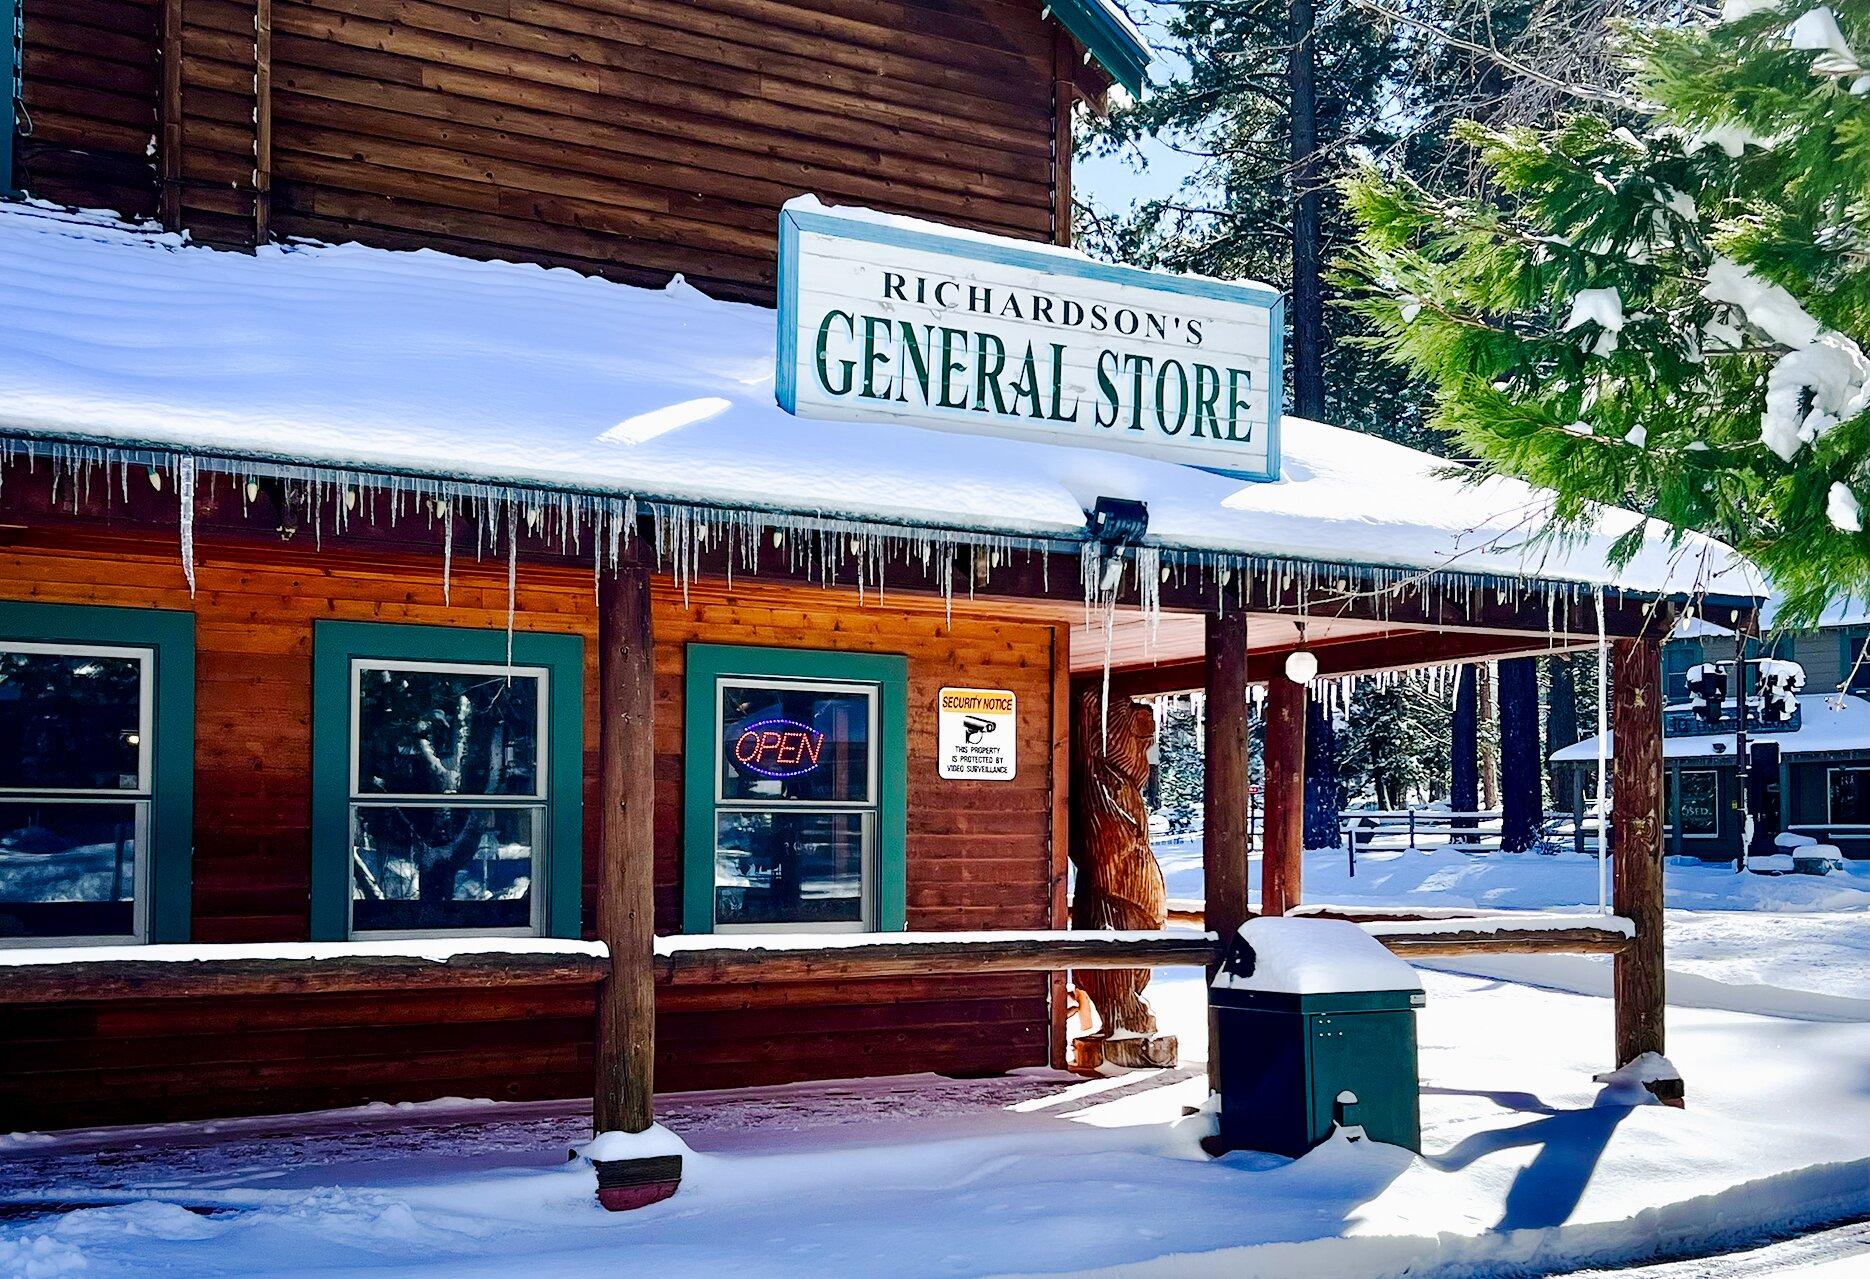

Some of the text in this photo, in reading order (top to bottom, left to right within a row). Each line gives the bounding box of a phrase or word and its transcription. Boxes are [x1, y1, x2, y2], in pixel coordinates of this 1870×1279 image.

[882, 271, 1204, 348] RICHARDSON'S
[815, 309, 1253, 443] GENERAL STORE
[942, 696, 1013, 711] SECURITY NOTICE
[735, 731, 825, 764] OPEN
[955, 745, 1001, 755] THIS PROPERTY
[951, 755, 958, 763] IS
[959, 755, 993, 764] PROTECTED
[946, 764, 1008, 774] VIDEO SURVEILLANCE
